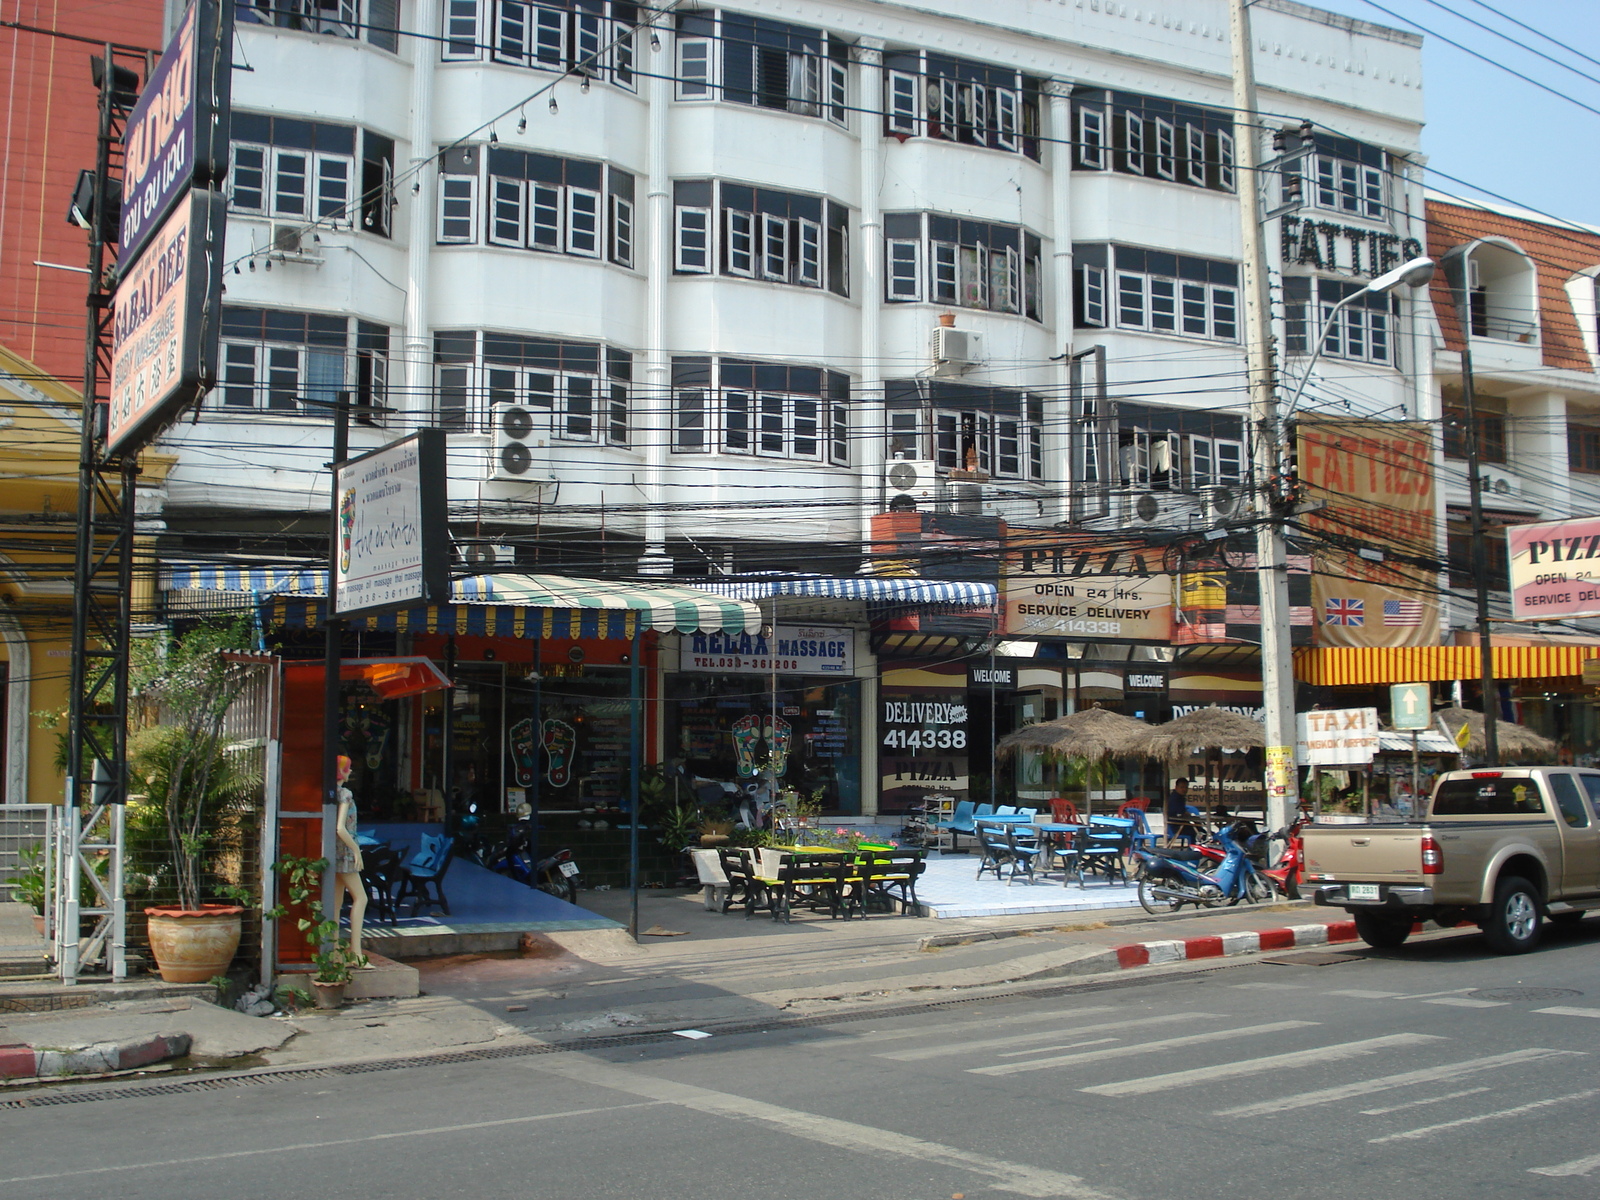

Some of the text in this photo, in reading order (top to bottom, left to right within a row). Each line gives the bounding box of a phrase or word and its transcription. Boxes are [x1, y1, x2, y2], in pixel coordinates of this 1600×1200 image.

[114, 268, 155, 354] SABAI
[156, 224, 187, 309] DEE
[1305, 432, 1431, 497] FATTIES
[1021, 549, 1151, 578] PIZZA
[1535, 572, 1567, 586] OPEN
[1034, 584, 1142, 600] OPEN 24 Hrs.
[1524, 592, 1571, 606] SERVICE
[1018, 603, 1150, 620] SERVICE DELIVERY
[1053, 619, 1121, 634] 414338
[693, 631, 845, 658] RELAX MASSAGE
[1129, 674, 1164, 688] WELCOME
[885, 702, 951, 724] DELIVERY
[1308, 711, 1367, 732] TAXI
[883, 729, 967, 749] 414338
[895, 761, 957, 781] PIZZA
